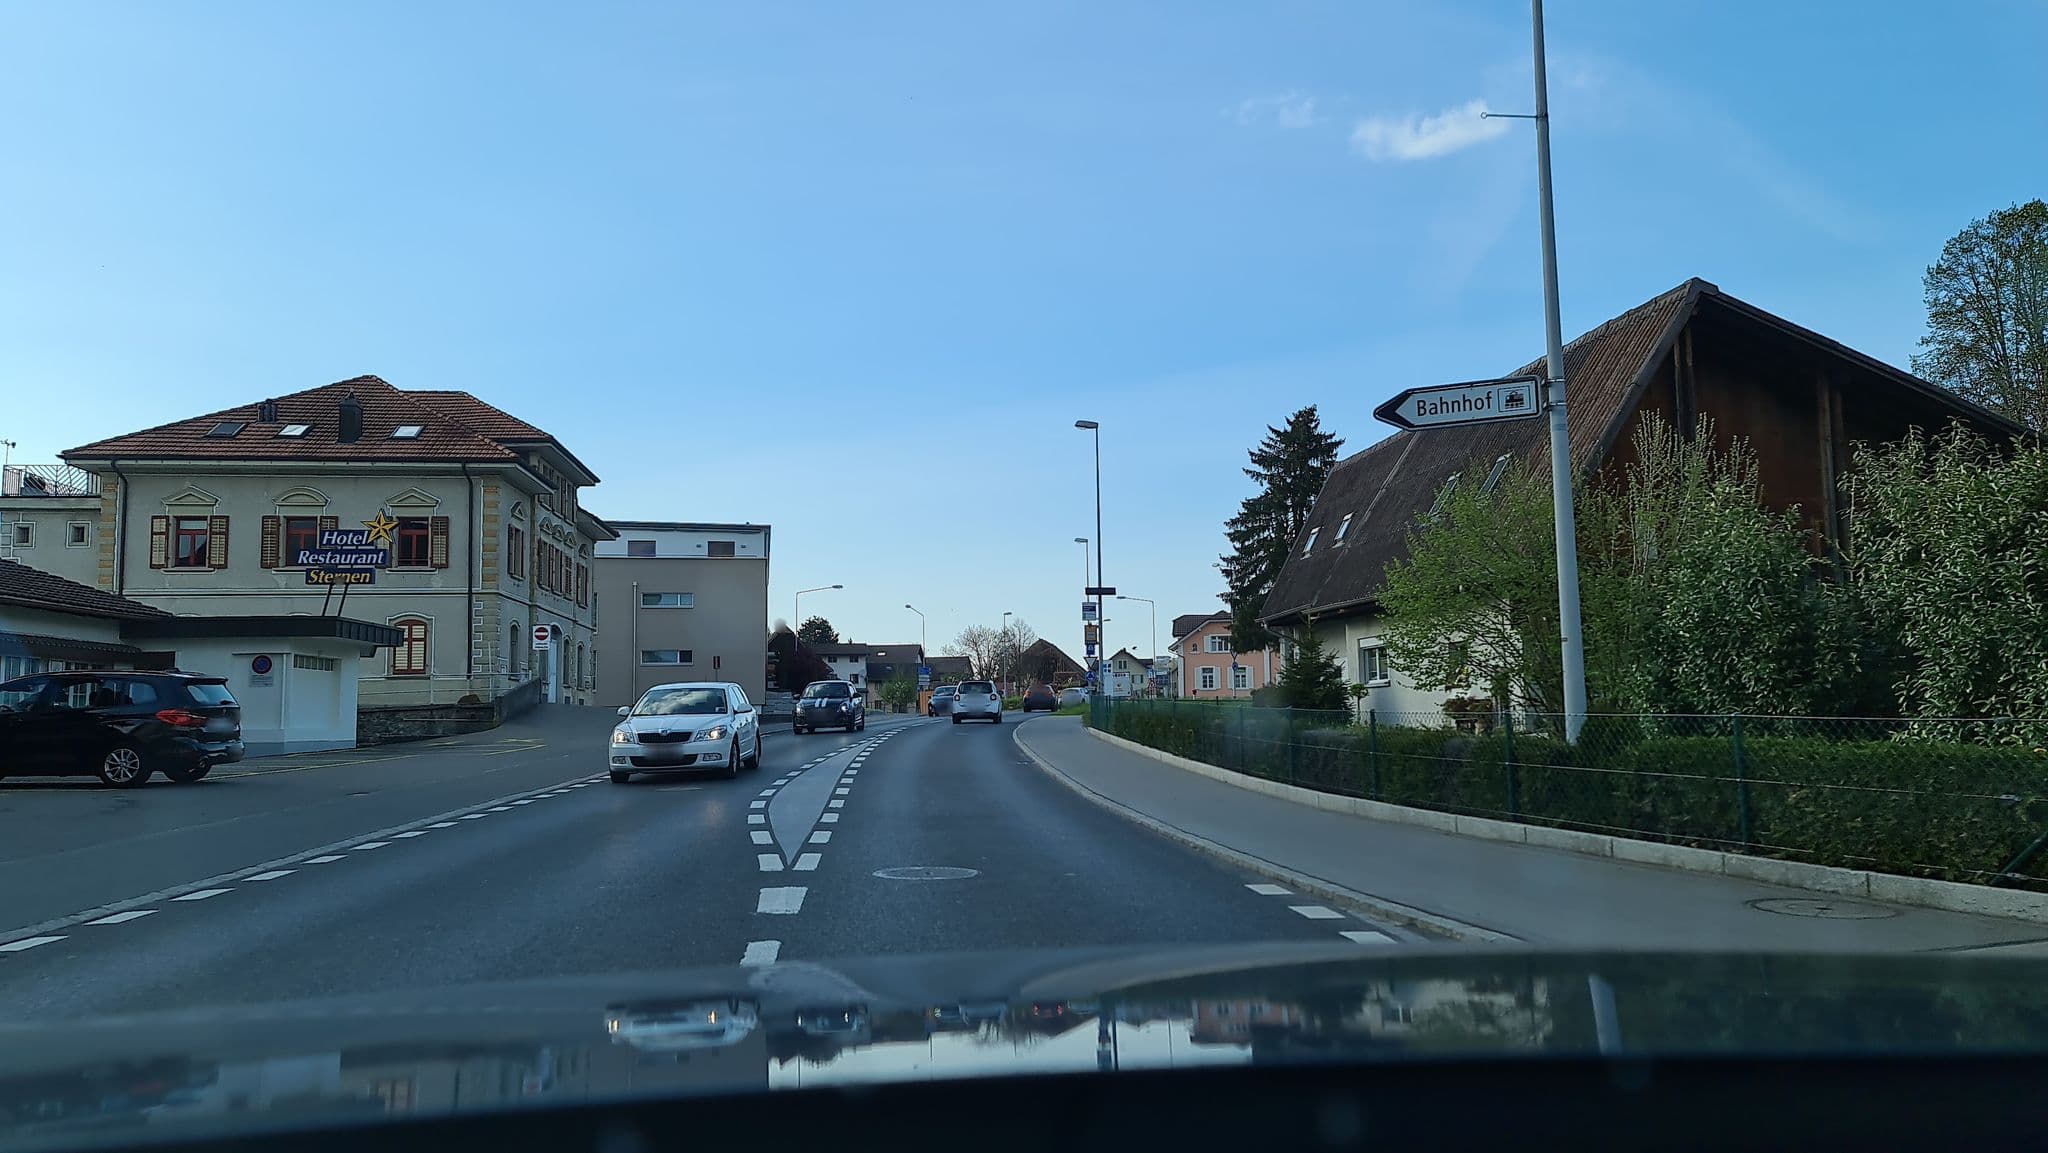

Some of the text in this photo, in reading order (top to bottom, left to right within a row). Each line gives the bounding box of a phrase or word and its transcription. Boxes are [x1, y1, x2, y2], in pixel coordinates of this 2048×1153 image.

[1417, 391, 1493, 416] Bahnhof
[322, 530, 369, 545] Hotel
[297, 550, 384, 564] Restaurant
